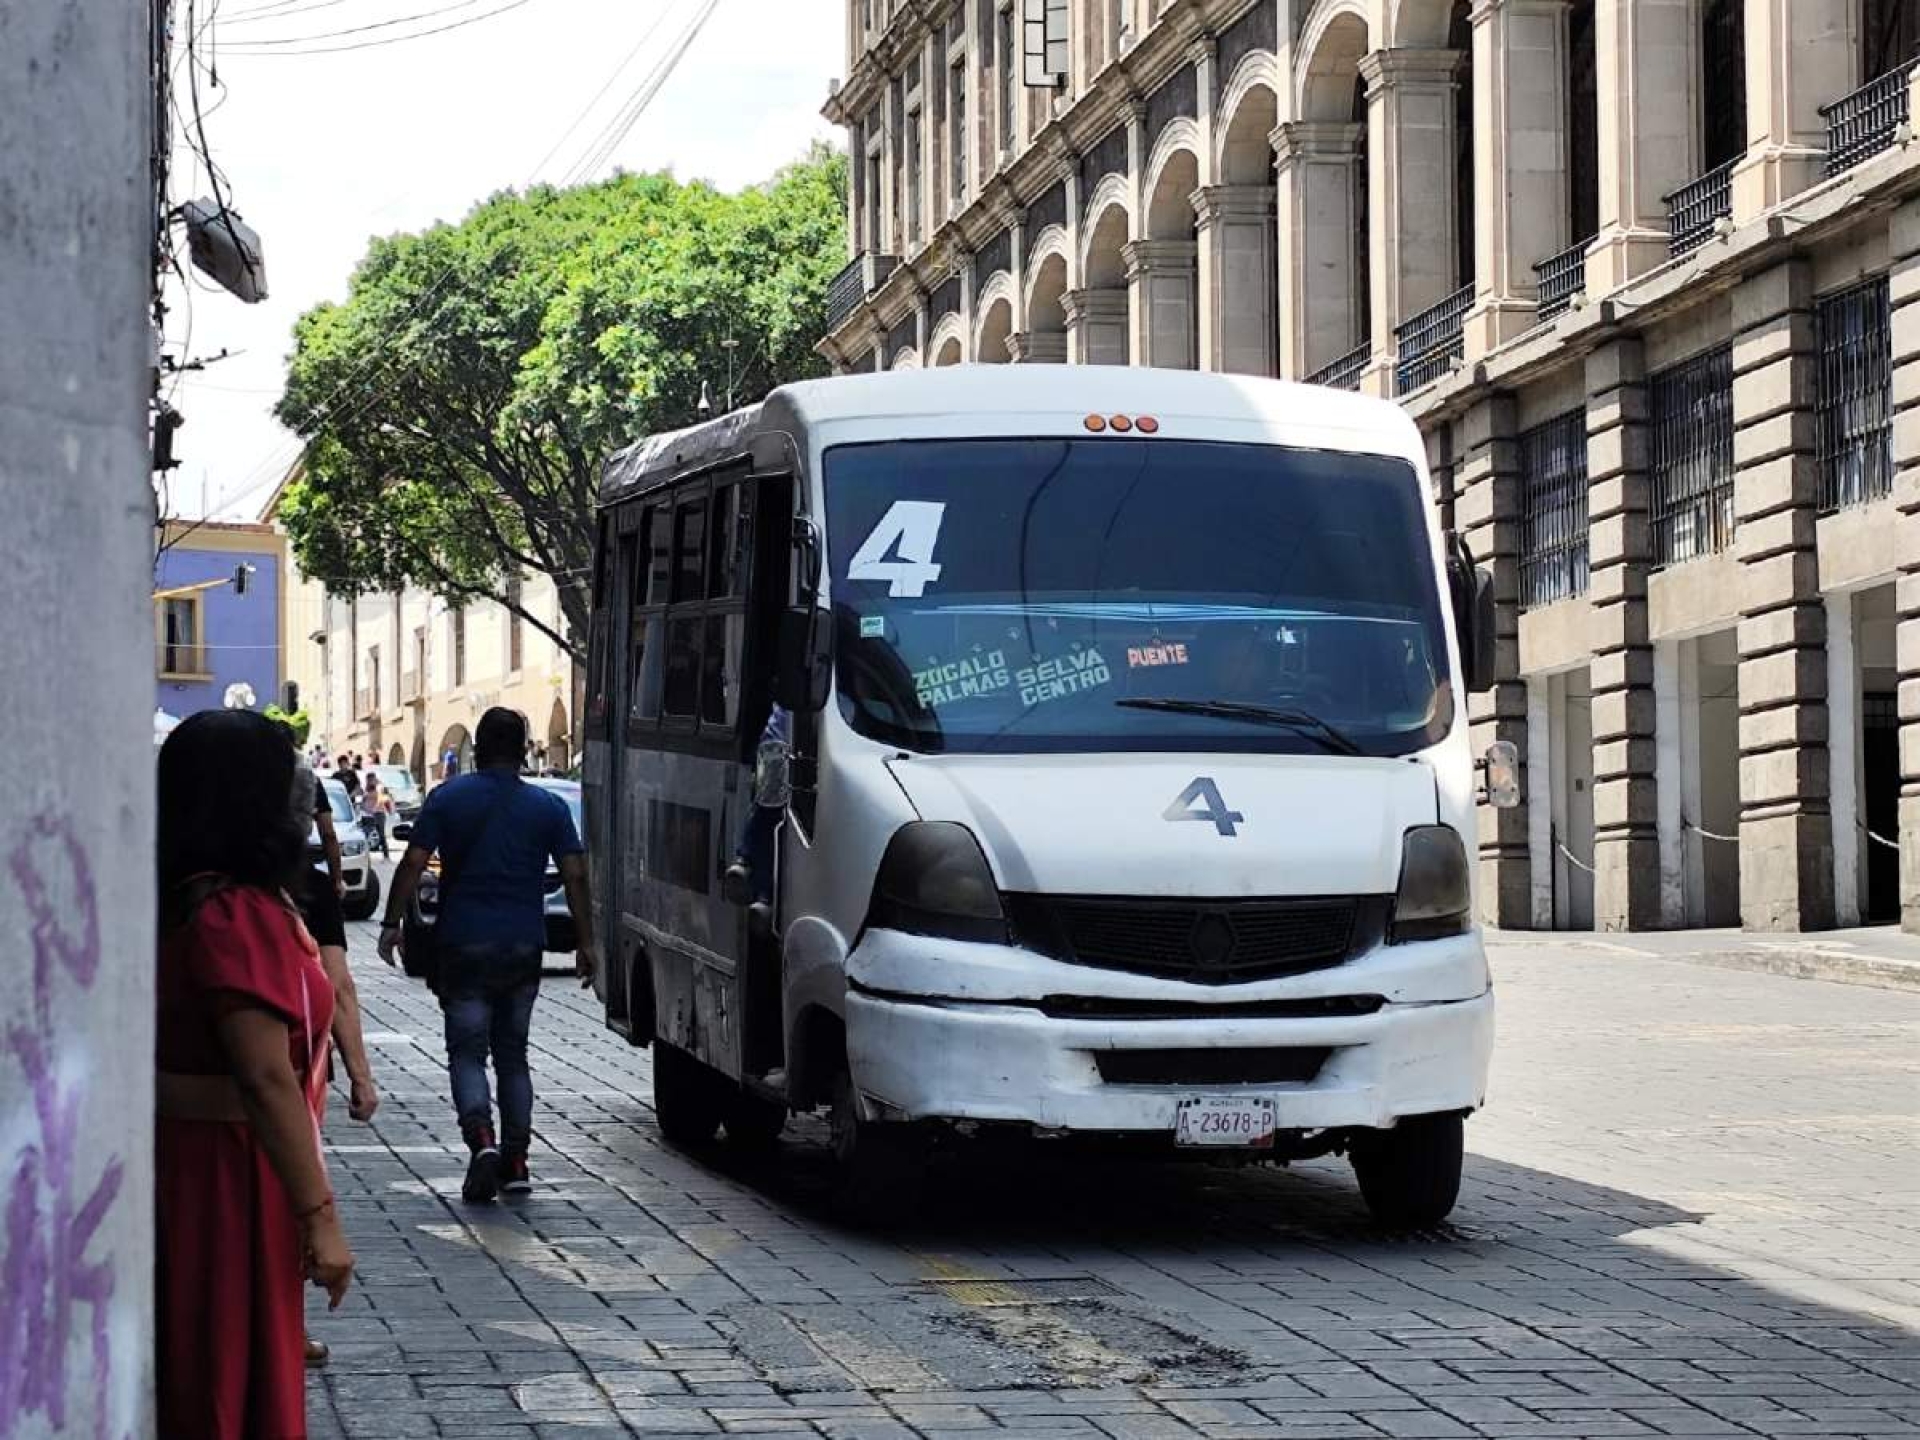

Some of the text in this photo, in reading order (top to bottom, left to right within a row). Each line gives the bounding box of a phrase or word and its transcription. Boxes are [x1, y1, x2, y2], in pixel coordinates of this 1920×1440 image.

[847, 500, 946, 598] 4
[1016, 648, 1104, 687] SELVA
[1127, 644, 1188, 667] PUENTE
[917, 669, 1010, 709] PALMAS
[1021, 665, 1110, 706] CENTRO
[1162, 777, 1244, 836] 4
[1180, 1111, 1272, 1134] A-23678-P
